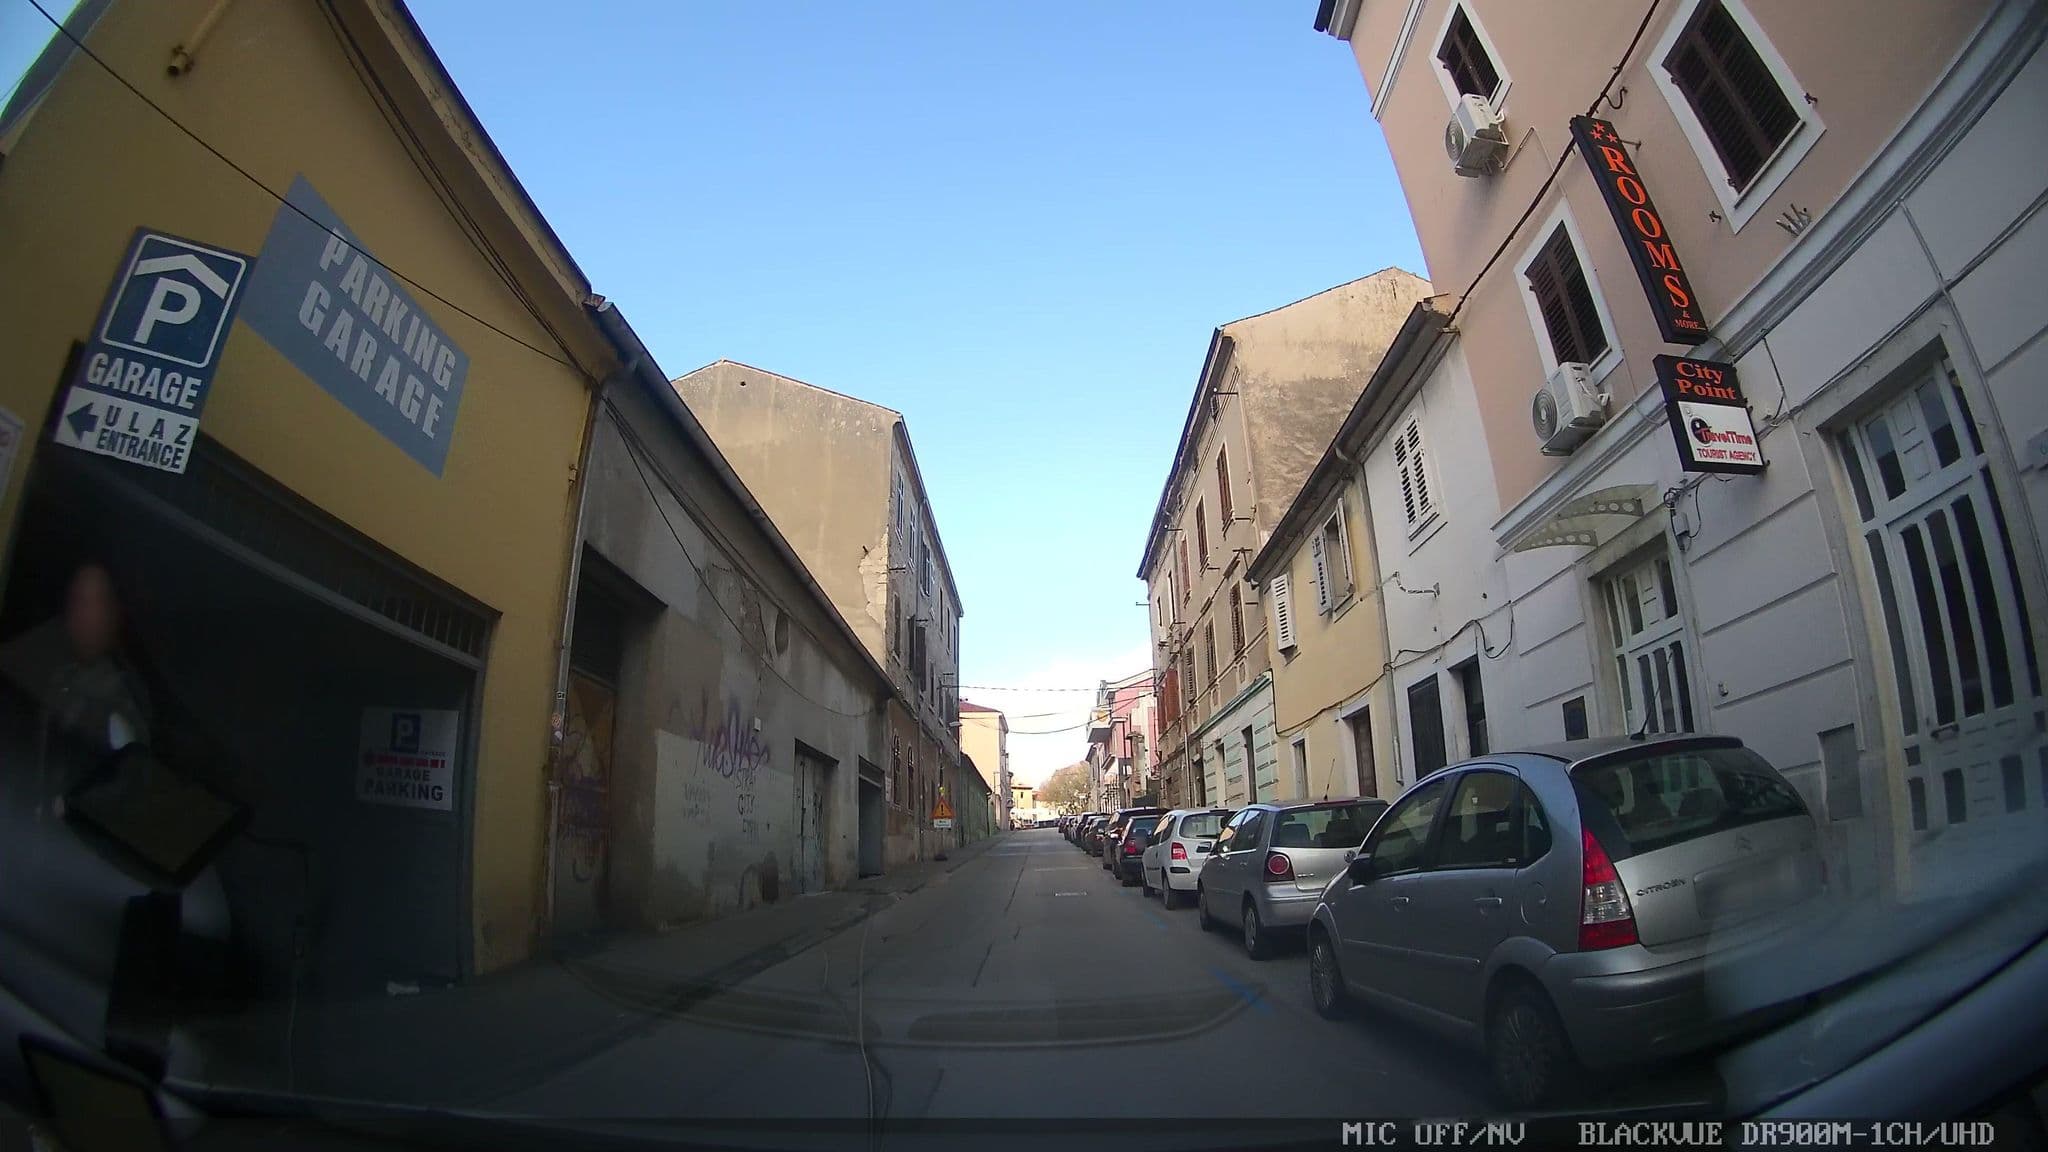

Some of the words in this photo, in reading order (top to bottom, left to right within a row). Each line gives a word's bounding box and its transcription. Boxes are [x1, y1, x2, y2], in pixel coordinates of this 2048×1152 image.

[1600, 145, 1689, 308] ROOMS
[134, 277, 201, 344] P
[319, 227, 456, 391] PARKING
[86, 352, 202, 410] GARAGE
[299, 280, 443, 439] GARAGE
[1676, 361, 1723, 384] City
[1676, 379, 1737, 400] Point
[96, 428, 185, 469] ENTRANCE
[1697, 448, 1728, 459] TOURIST
[366, 777, 444, 802] PARKING
